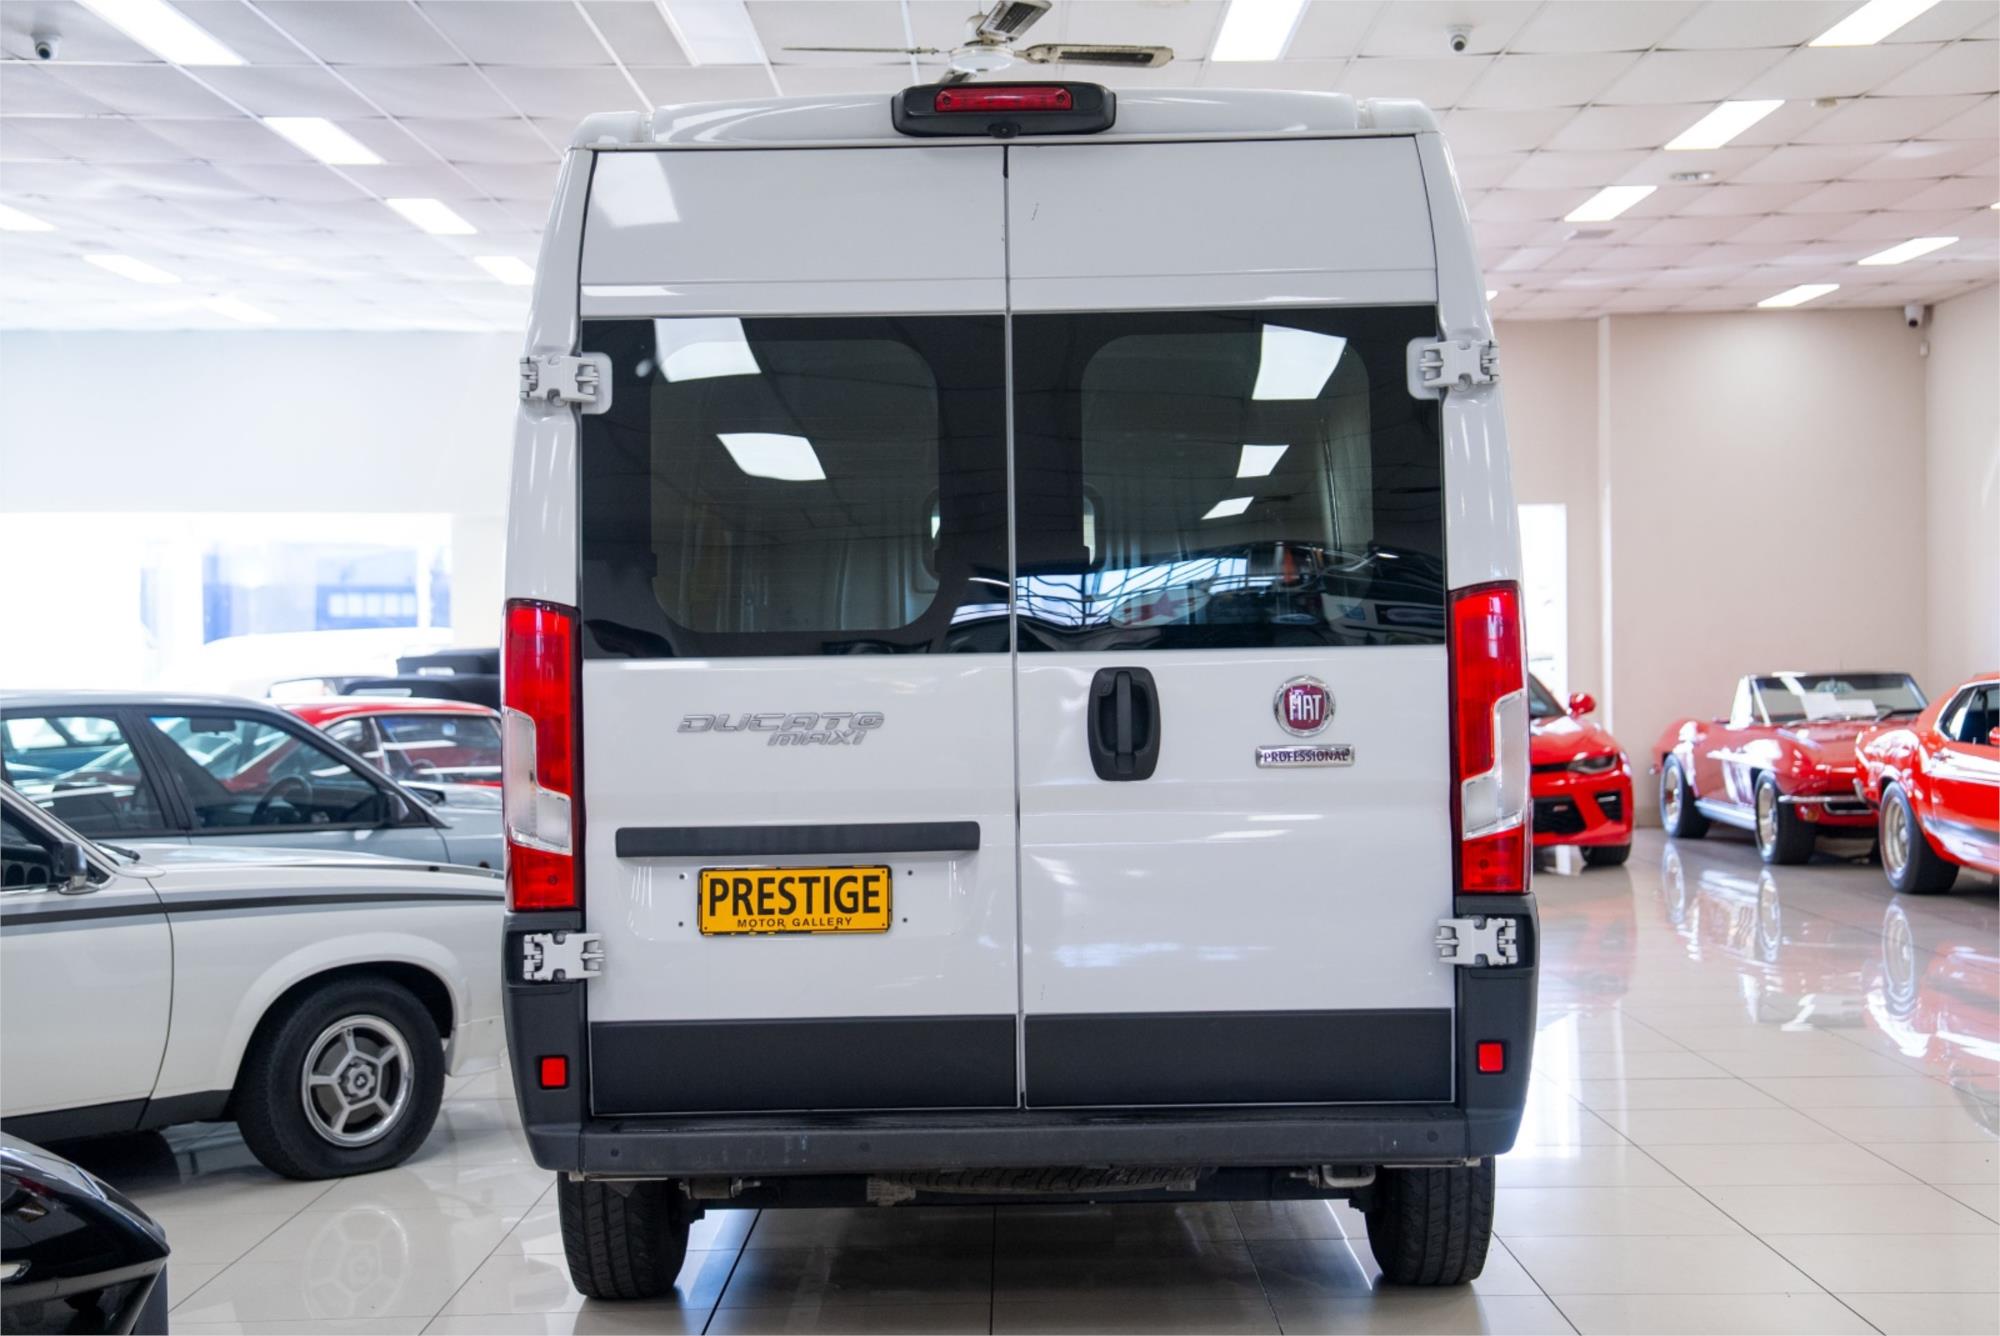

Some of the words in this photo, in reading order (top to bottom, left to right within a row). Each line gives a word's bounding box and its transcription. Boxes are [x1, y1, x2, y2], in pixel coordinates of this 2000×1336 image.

[1289, 693, 1322, 721] FIAT
[677, 711, 885, 733] DUCATO
[1264, 750, 1348, 763] PROFESSIONAL
[709, 875, 880, 917] PRESTIGE
[737, 918, 786, 929] MOTOR
[791, 917, 853, 927] GALLERY
